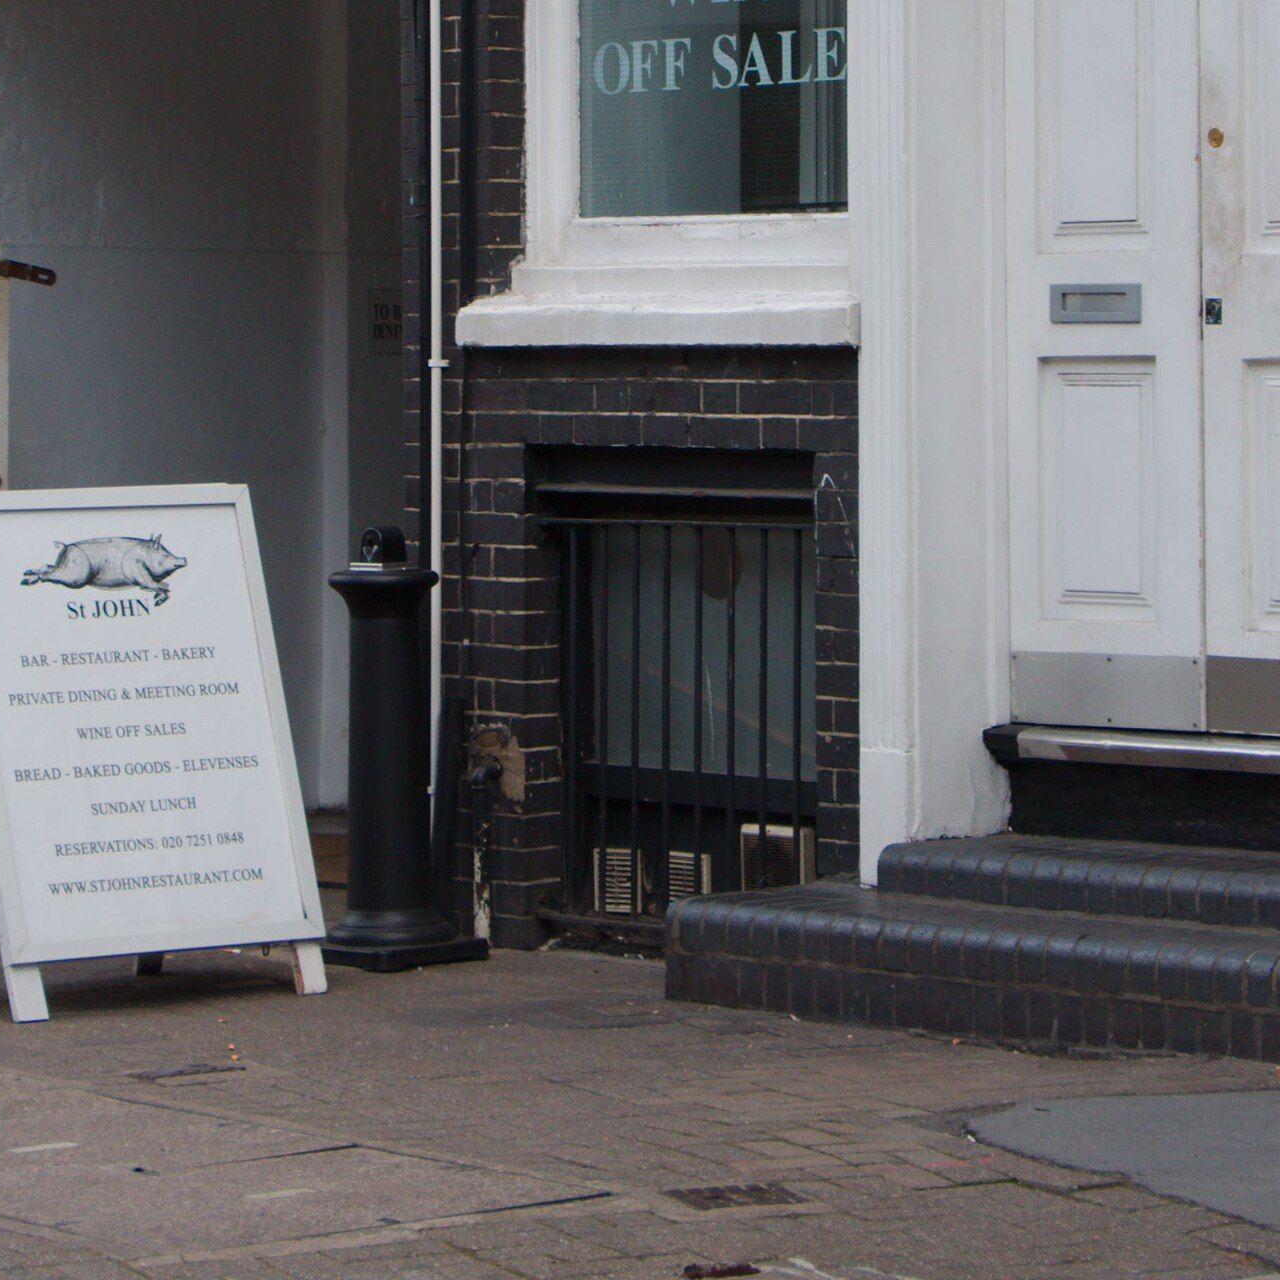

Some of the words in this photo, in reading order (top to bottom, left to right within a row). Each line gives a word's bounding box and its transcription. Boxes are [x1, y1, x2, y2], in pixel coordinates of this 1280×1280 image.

[593, 38, 692, 95] OFF
[66, 601, 86, 620] St
[92, 598, 151, 619] JOHN
[20, 654, 50, 668] BAR
[60, 649, 150, 666] RESTAURANT
[162, 646, 216, 662] BAKERY
[8, 691, 64, 707] PRIVATE
[68, 687, 117, 704] DINING
[121, 687, 131, 700] &
[135, 683, 196, 700] MEETING
[199, 682, 240, 696] ROOM
[76, 726, 113, 741] WINE
[115, 724, 141, 738] OFF
[144, 722, 187, 737] SALES
[14, 767, 61, 782] BREAD
[74, 763, 121, 779] BAKED
[124, 761, 171, 776] GOODS
[183, 755, 259, 773] ELEVENSES
[91, 800, 146, 816] SUNDAY
[150, 797, 197, 813] LUNCH
[54, 837, 158, 857] RESERVATIONS:
[161, 836, 183, 850] 020
[186, 833, 213, 848] 7251
[216, 831, 245, 845] 0848
[48, 868, 264, 896] WWW.STJOHNRESTAURANT.COM
